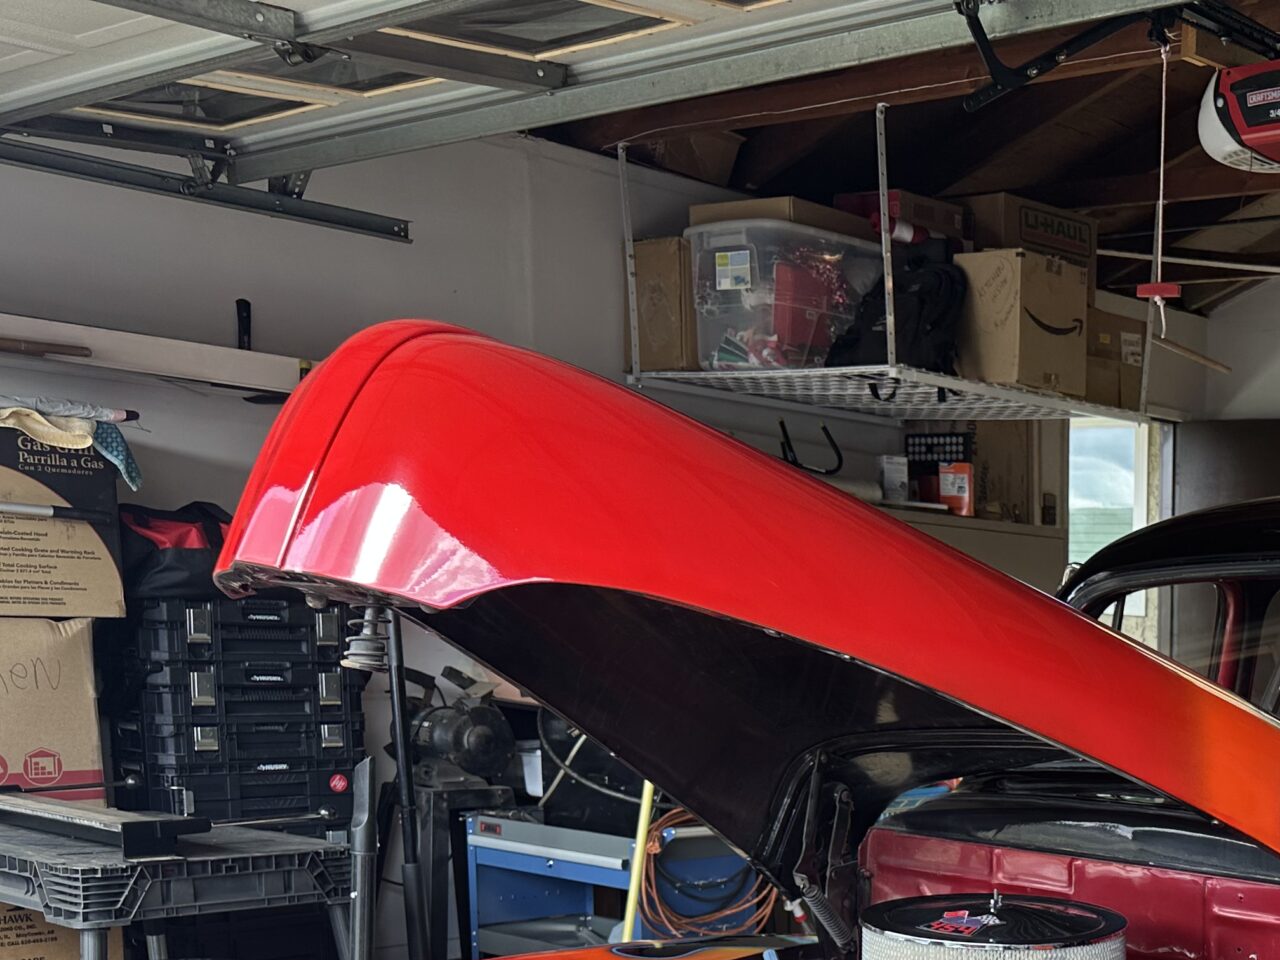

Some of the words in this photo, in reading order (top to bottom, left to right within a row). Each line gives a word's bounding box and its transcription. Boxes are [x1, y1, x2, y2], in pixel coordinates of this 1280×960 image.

[1269, 109, 1280, 118] 3/4
[1024, 211, 1089, 243] U-HAUL
[18, 436, 50, 451] Gas
[18, 451, 67, 466] Parrilla
[70, 459, 77, 467] a
[81, 456, 104, 469] Gas
[44, 466, 93, 475] Quemadores
[930, 921, 978, 936] 454
